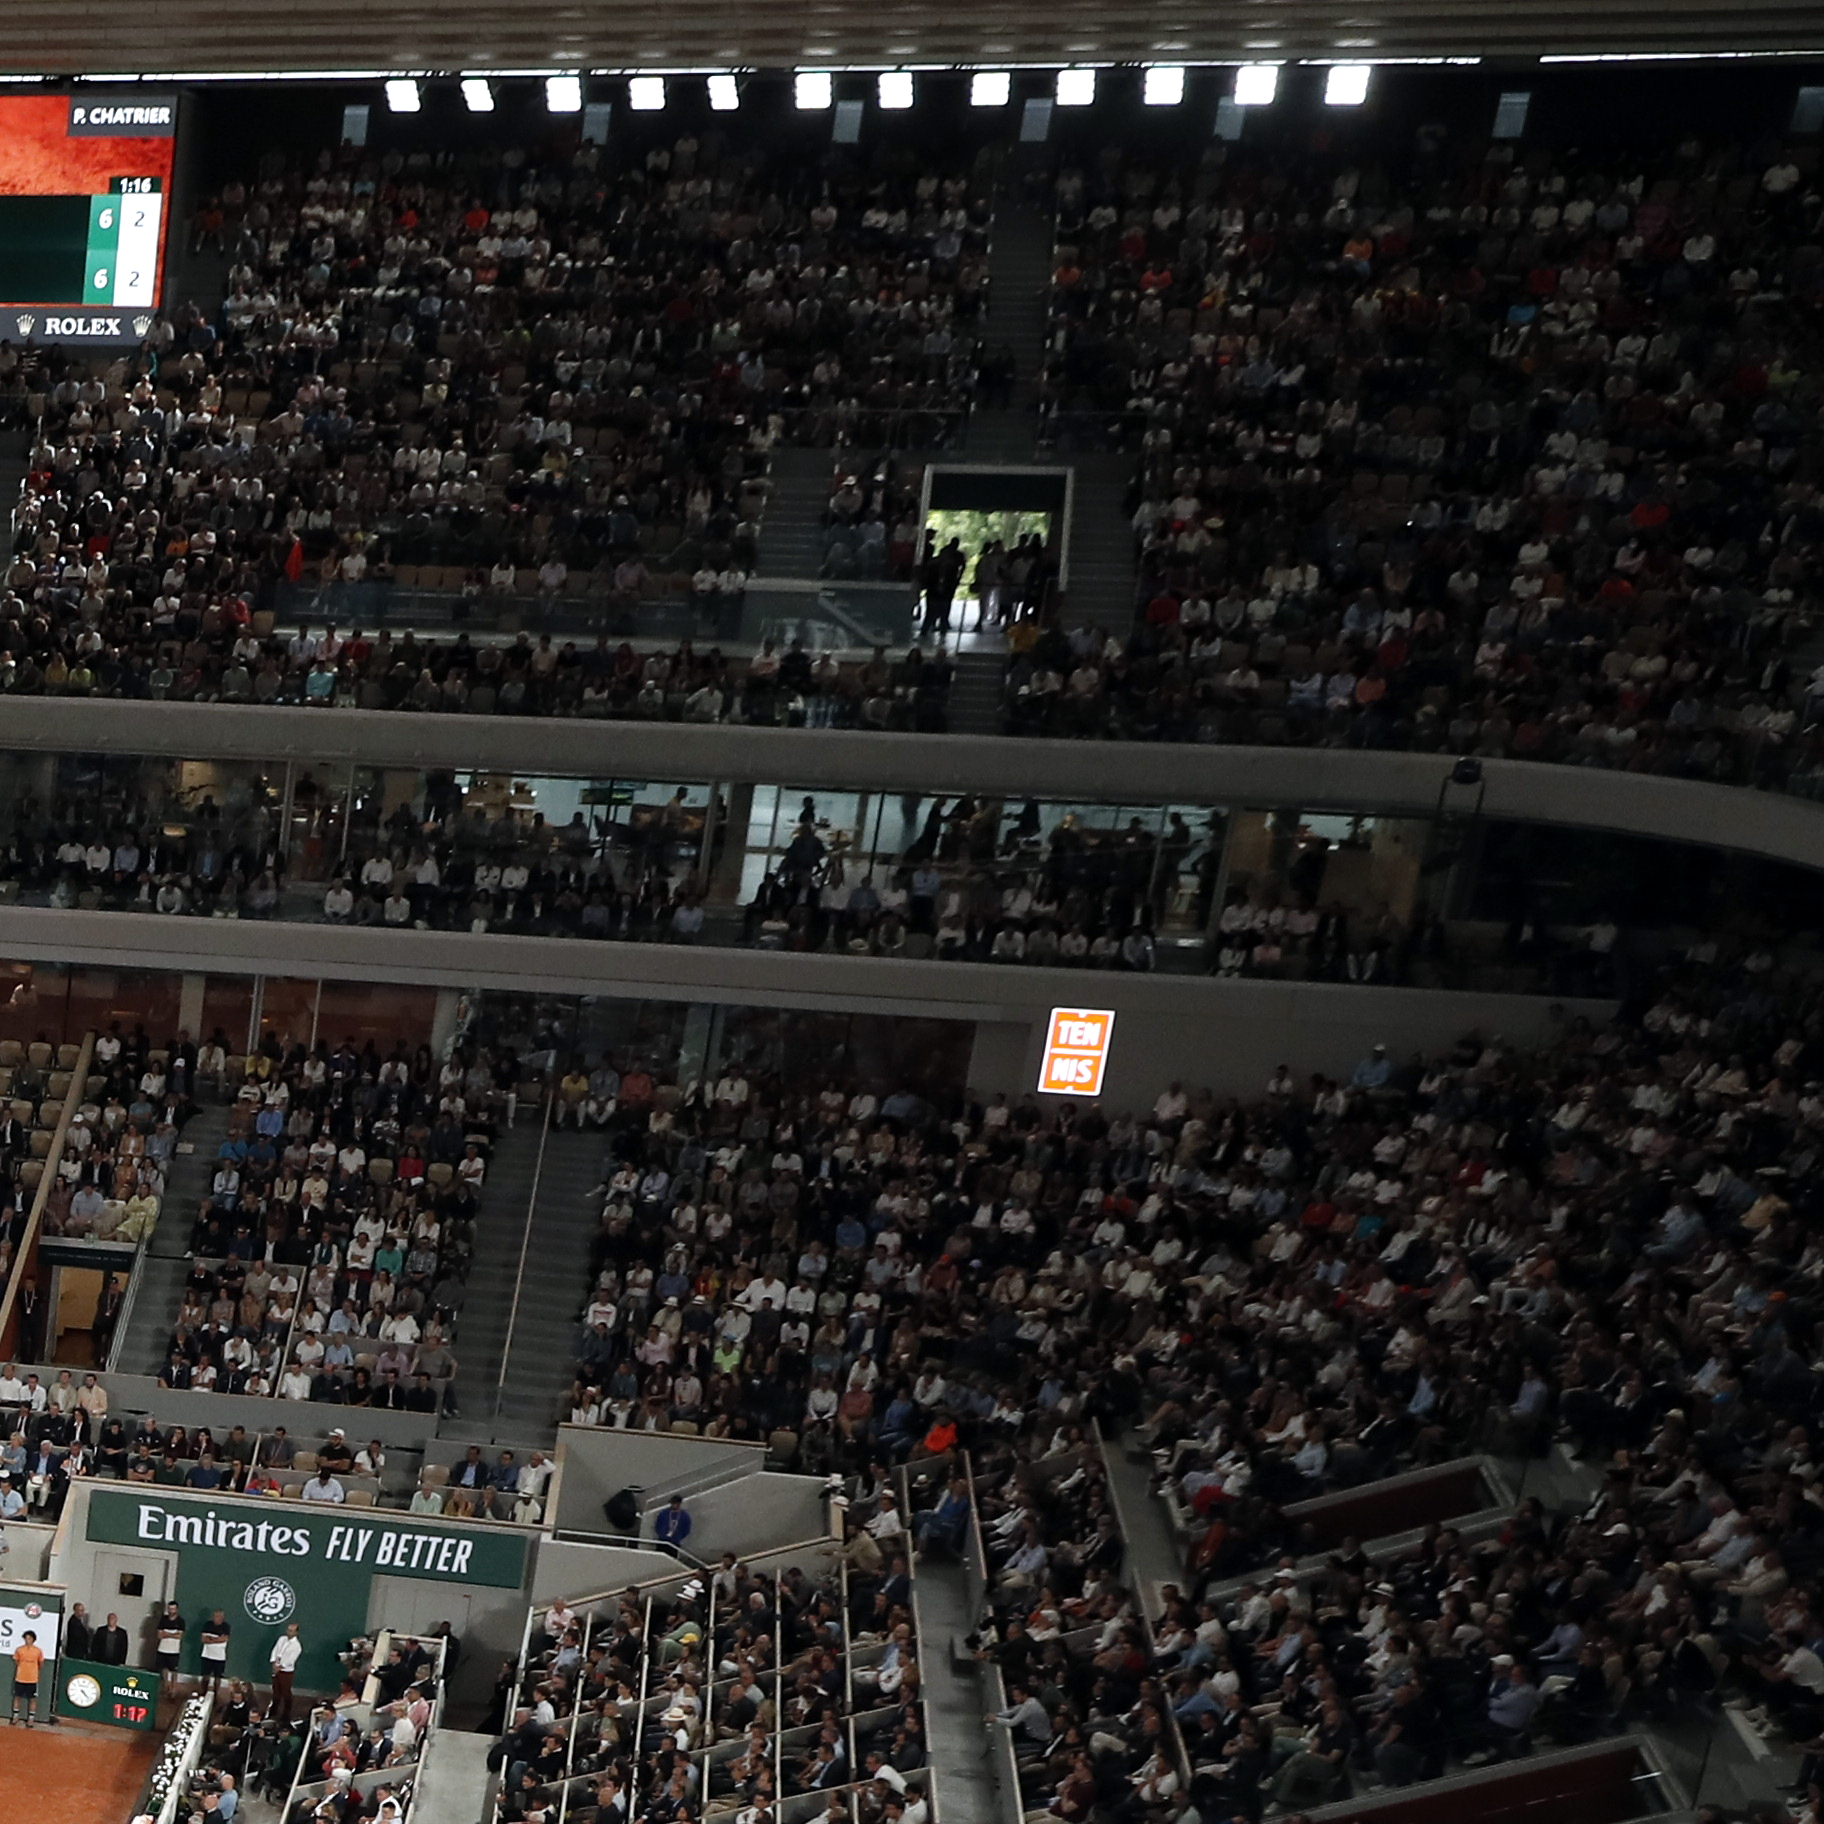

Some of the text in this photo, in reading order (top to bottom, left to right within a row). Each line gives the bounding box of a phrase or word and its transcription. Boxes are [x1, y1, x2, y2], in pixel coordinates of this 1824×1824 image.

[73, 107, 171, 125] P. CHATRIER
[119, 178, 151, 192] 1:16
[98, 209, 113, 229] 6
[134, 211, 144, 227] 2
[93, 270, 108, 289] 6
[128, 272, 139, 287] 2
[45, 318, 120, 336] ROLEX
[1058, 1020, 1102, 1046] TEN
[1050, 1058, 1094, 1083] NIS
[138, 1503, 473, 1574] Emirates FLY BETTER
[113, 1686, 149, 1700] ROLEX
[114, 1703, 148, 1723] 1:17
